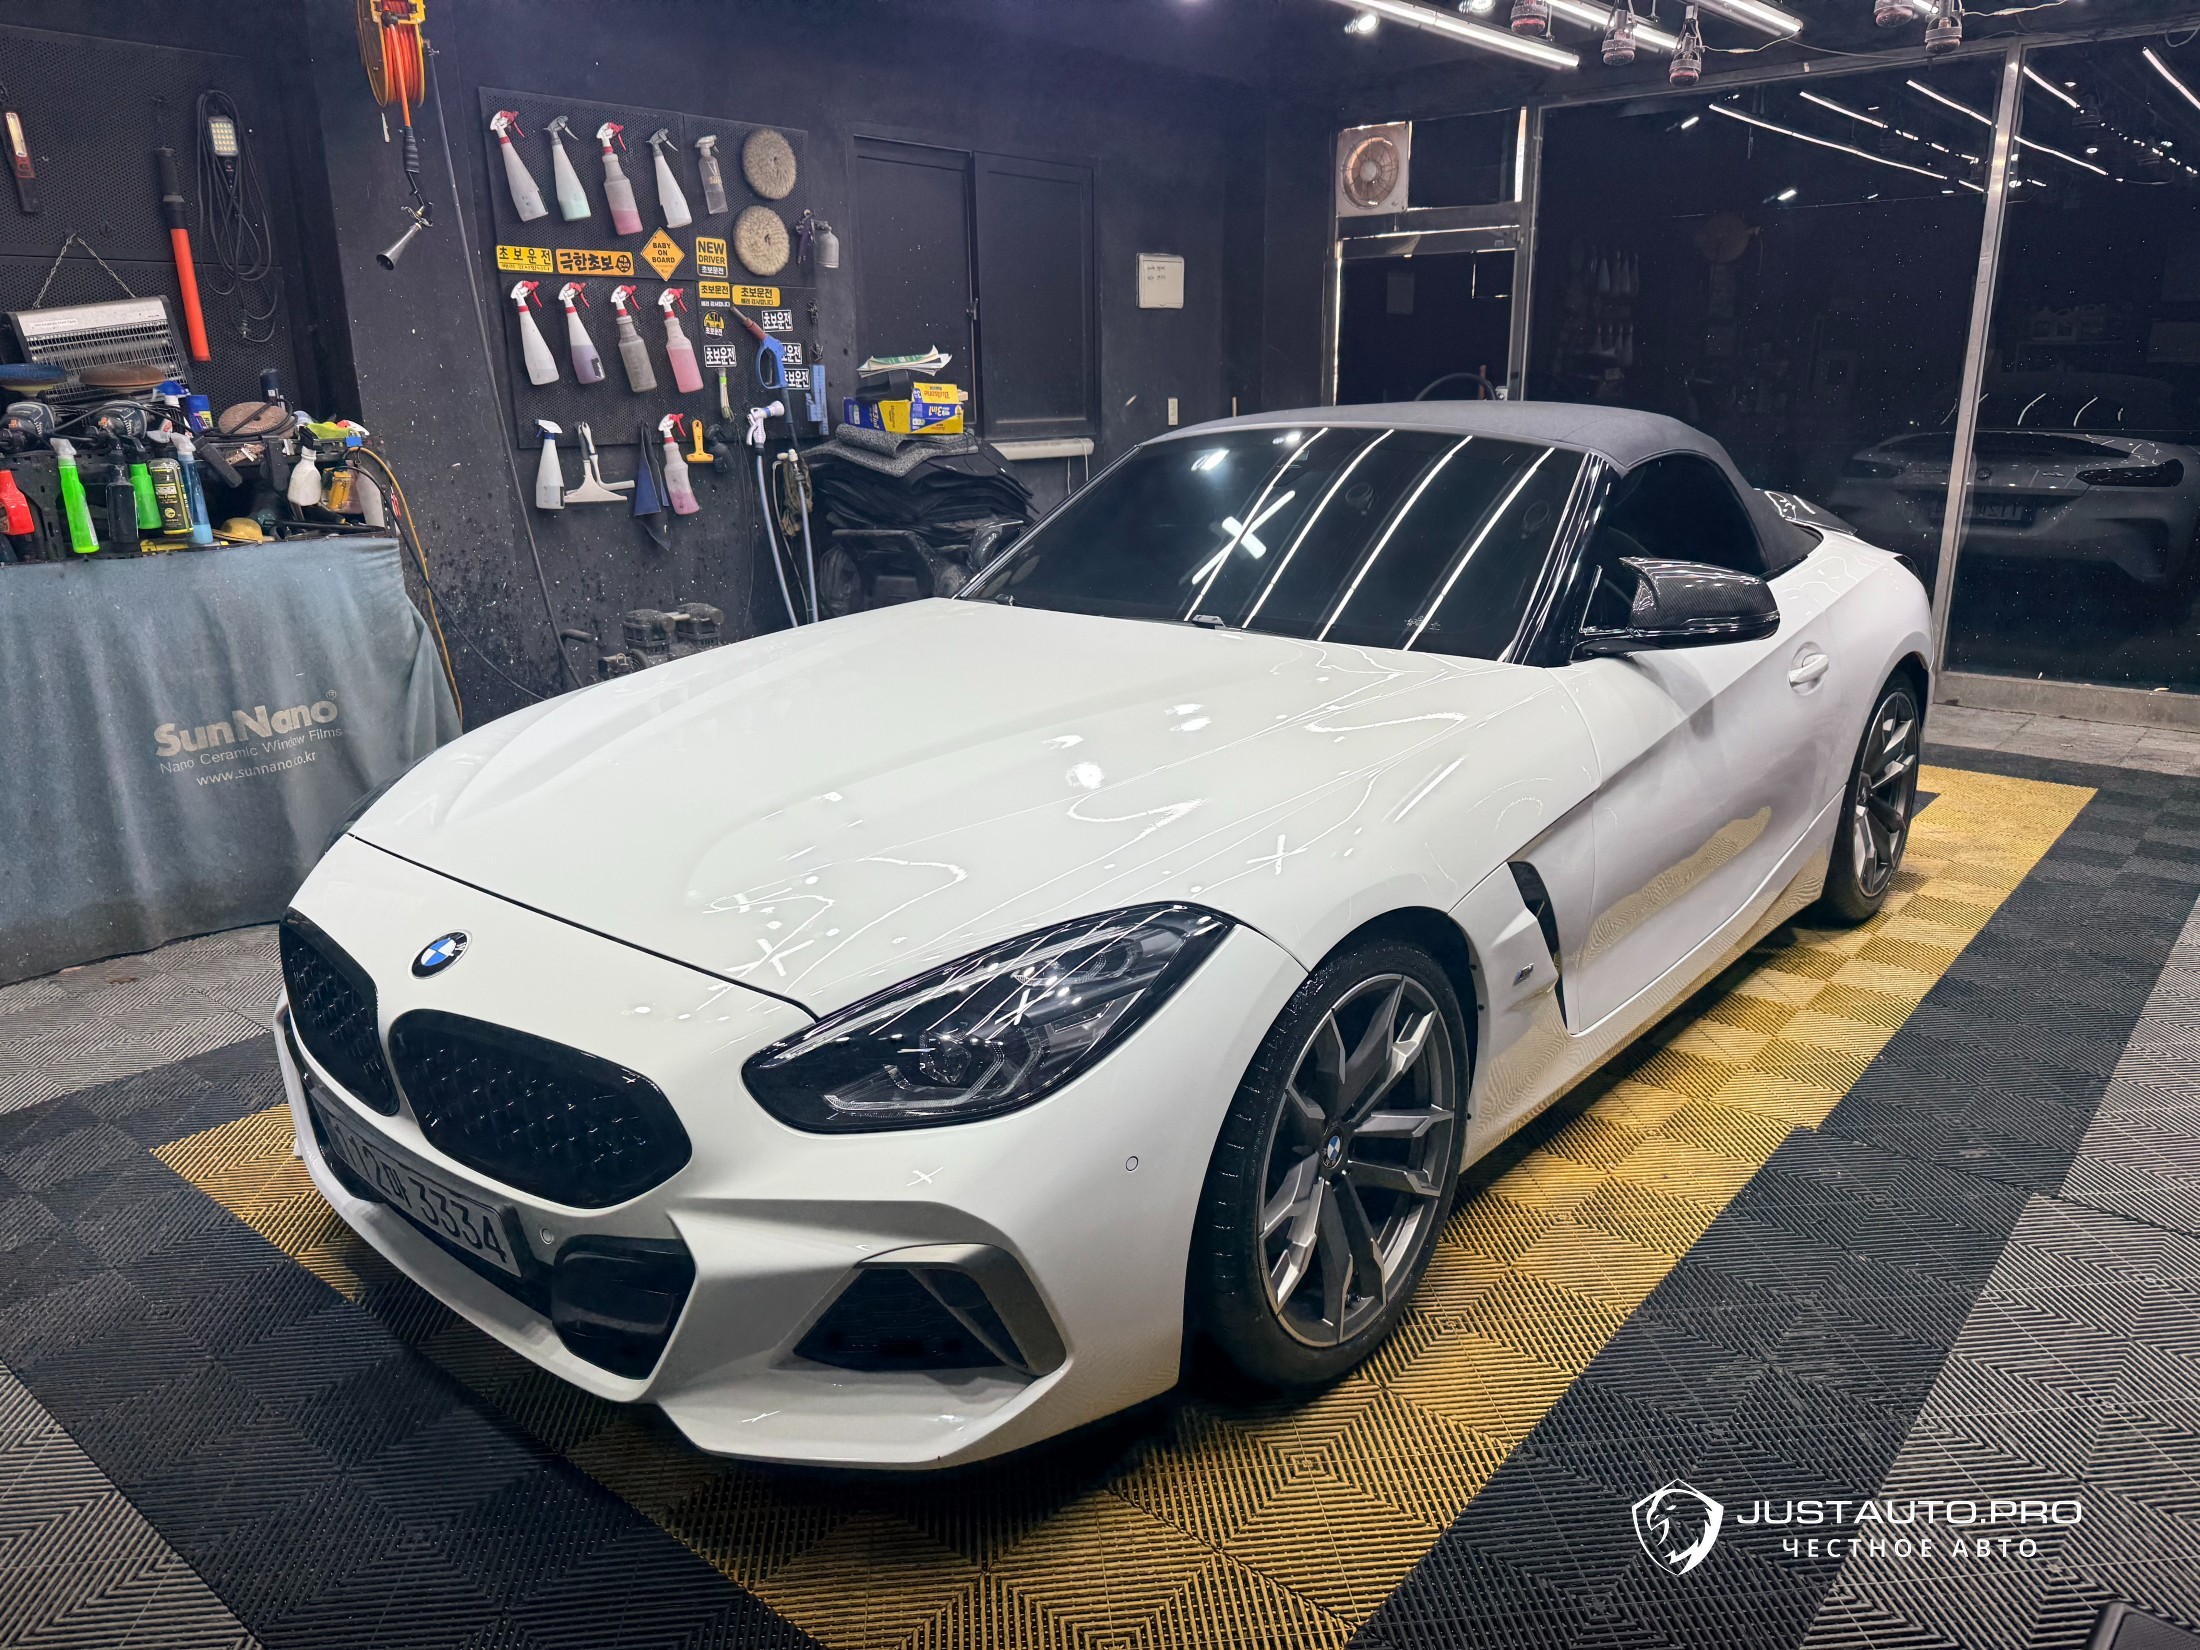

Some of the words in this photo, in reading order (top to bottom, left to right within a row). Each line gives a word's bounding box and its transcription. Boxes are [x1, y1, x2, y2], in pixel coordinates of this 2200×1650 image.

[499, 246, 551, 265] 초보운전
[697, 240, 725, 255] NEW
[559, 251, 614, 271] 극한초보
[698, 254, 726, 265] DRIVER
[701, 265, 724, 275] 초보운전
[701, 284, 729, 295] 초보운전
[741, 287, 773, 299] 초보운전
[763, 312, 792, 330] 초보운전
[706, 347, 736, 365] 초보운전
[153, 721, 235, 757] Sun
[160, 758, 195, 775] Nano
[200, 745, 258, 765] Ceramic
[261, 735, 305, 753] Window
[309, 728, 343, 741] Films
[196, 751, 317, 786] www.sunnano.co.kr
[407, 1175, 507, 1264] 3334
